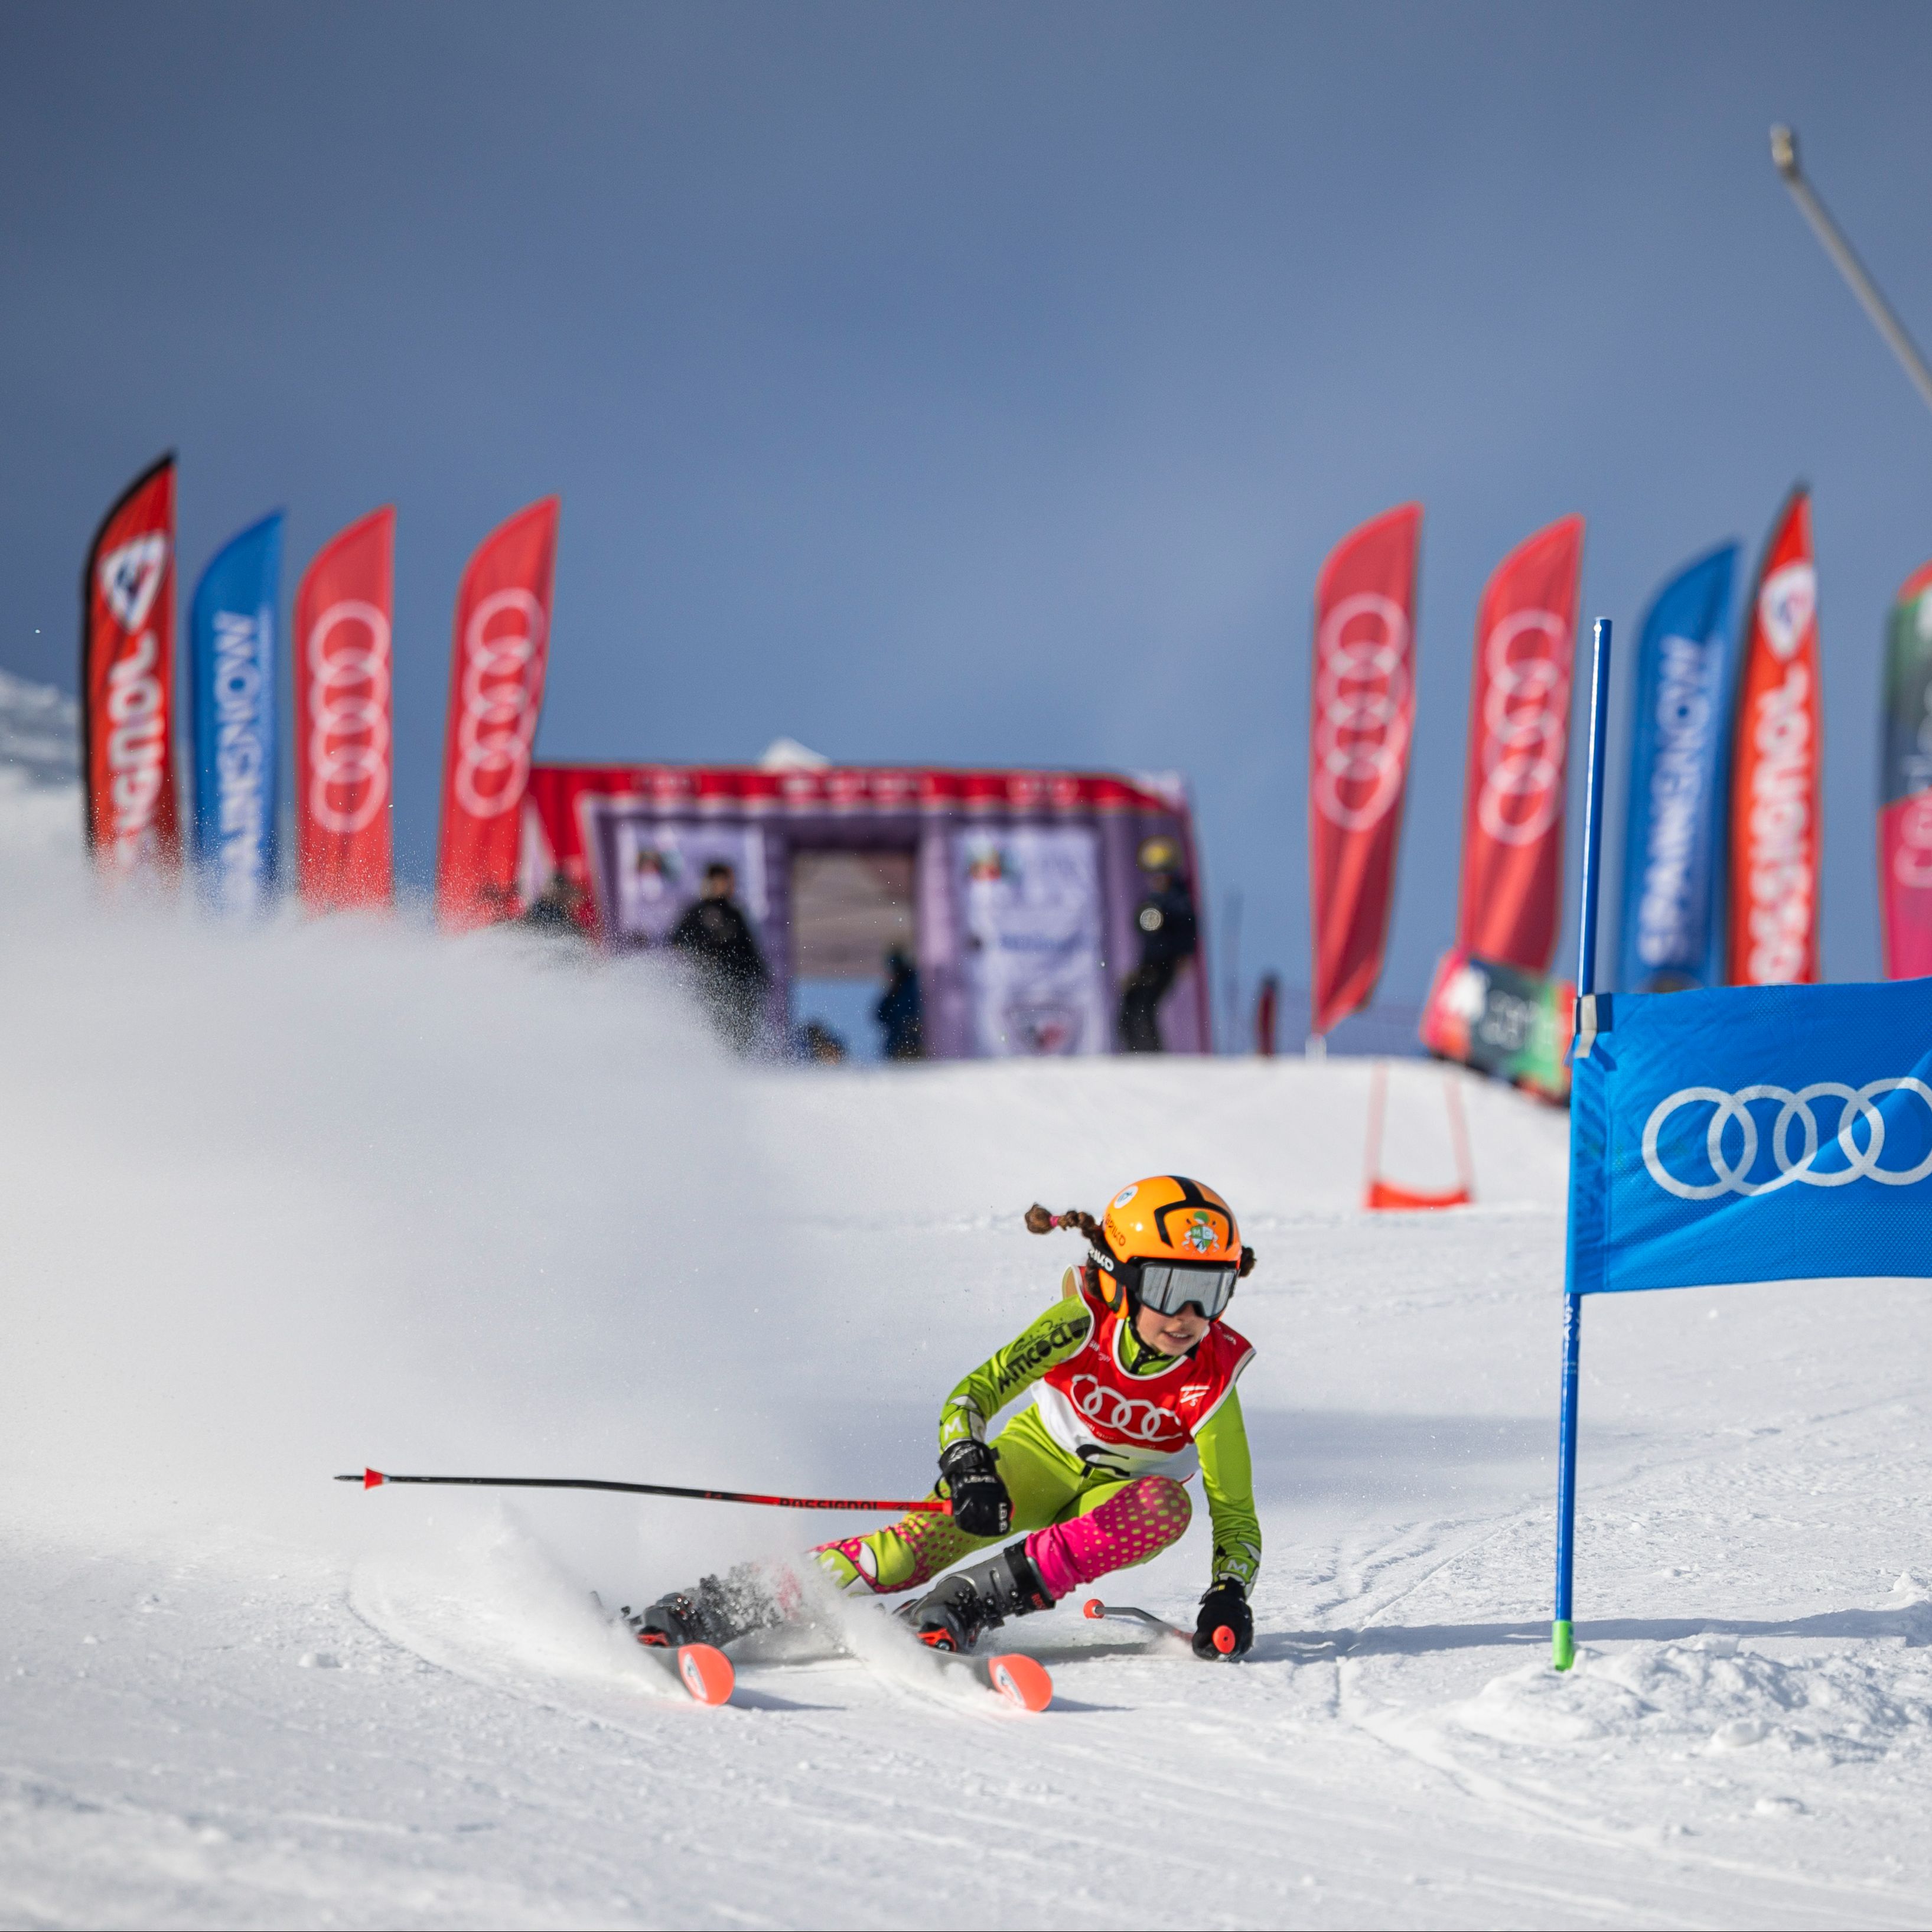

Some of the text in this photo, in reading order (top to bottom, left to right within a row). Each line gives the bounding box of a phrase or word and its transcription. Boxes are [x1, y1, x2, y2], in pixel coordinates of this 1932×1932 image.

[1749, 659, 1812, 983] OSSIGNOL
[1089, 1246, 1115, 1271] RIKO
[998, 1316, 1091, 1395] MITICOCLU
[945, 1417, 964, 1440] M
[964, 1474, 998, 1484] LEVEL
[1227, 1559, 1248, 1574] M
